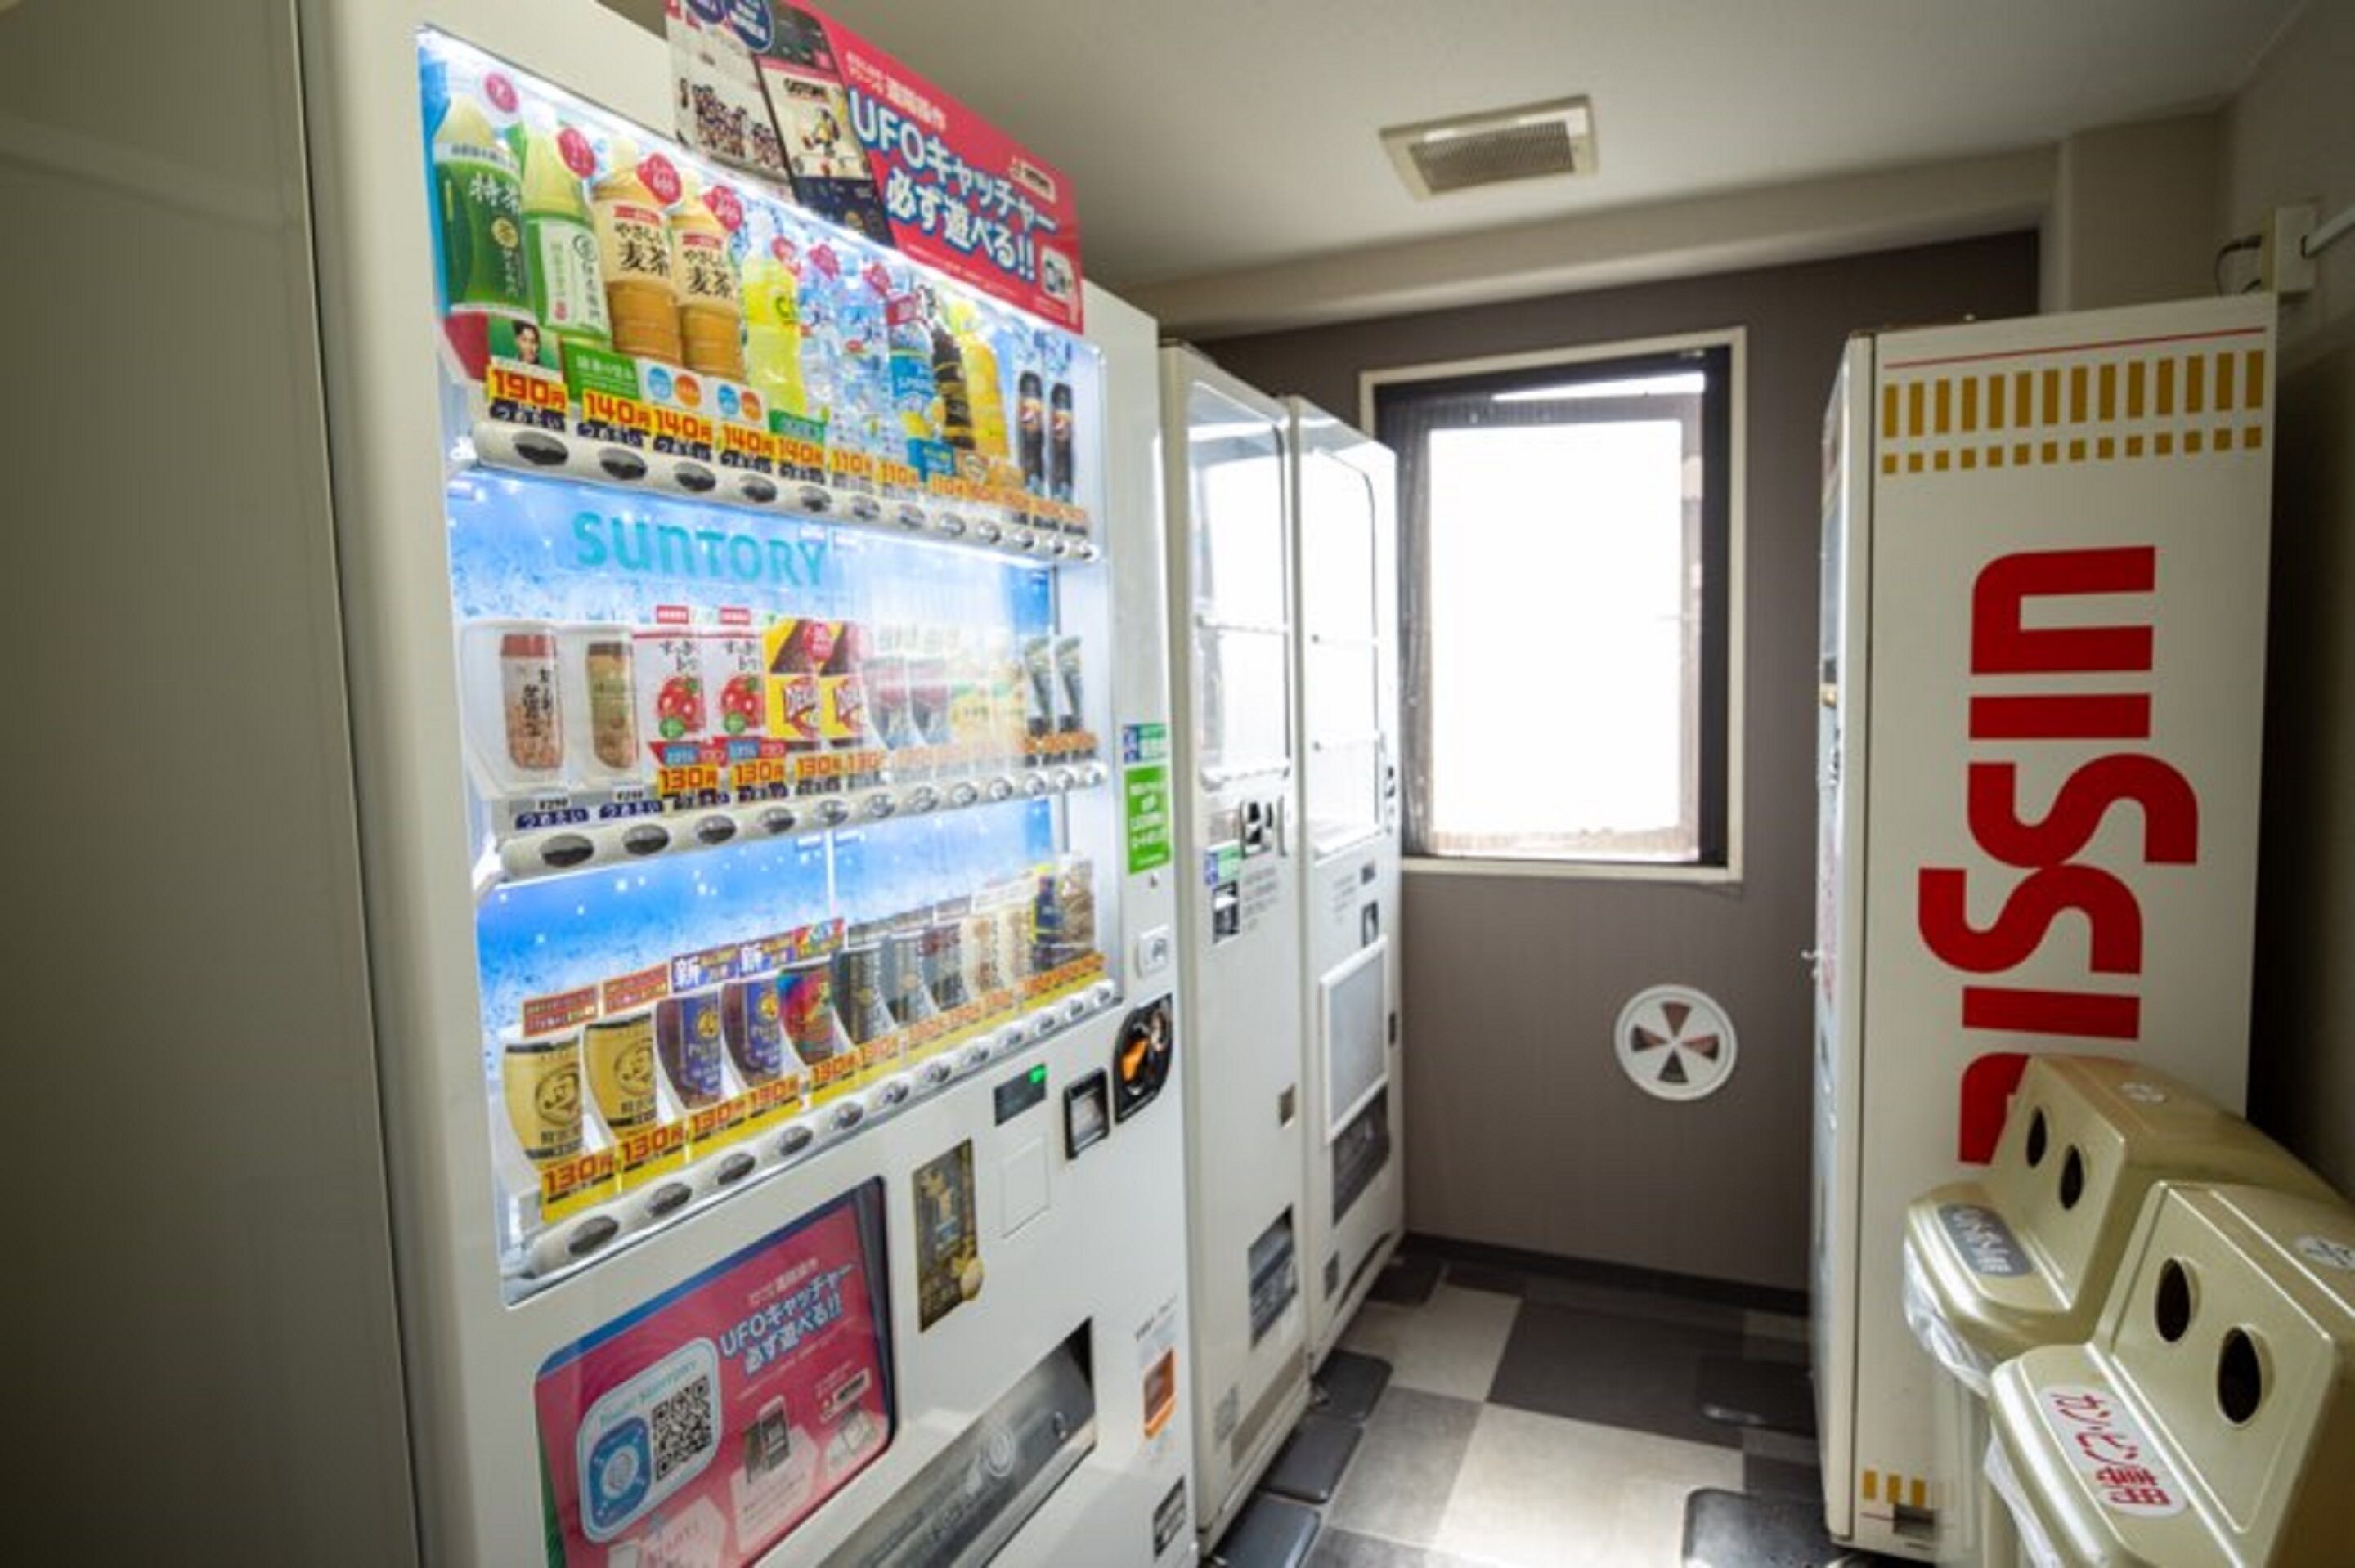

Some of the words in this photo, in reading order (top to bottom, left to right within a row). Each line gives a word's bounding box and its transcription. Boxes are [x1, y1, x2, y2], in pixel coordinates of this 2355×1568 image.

[849, 87, 1058, 232] UFOキャッチャー
[573, 510, 828, 586] SUNTORY
